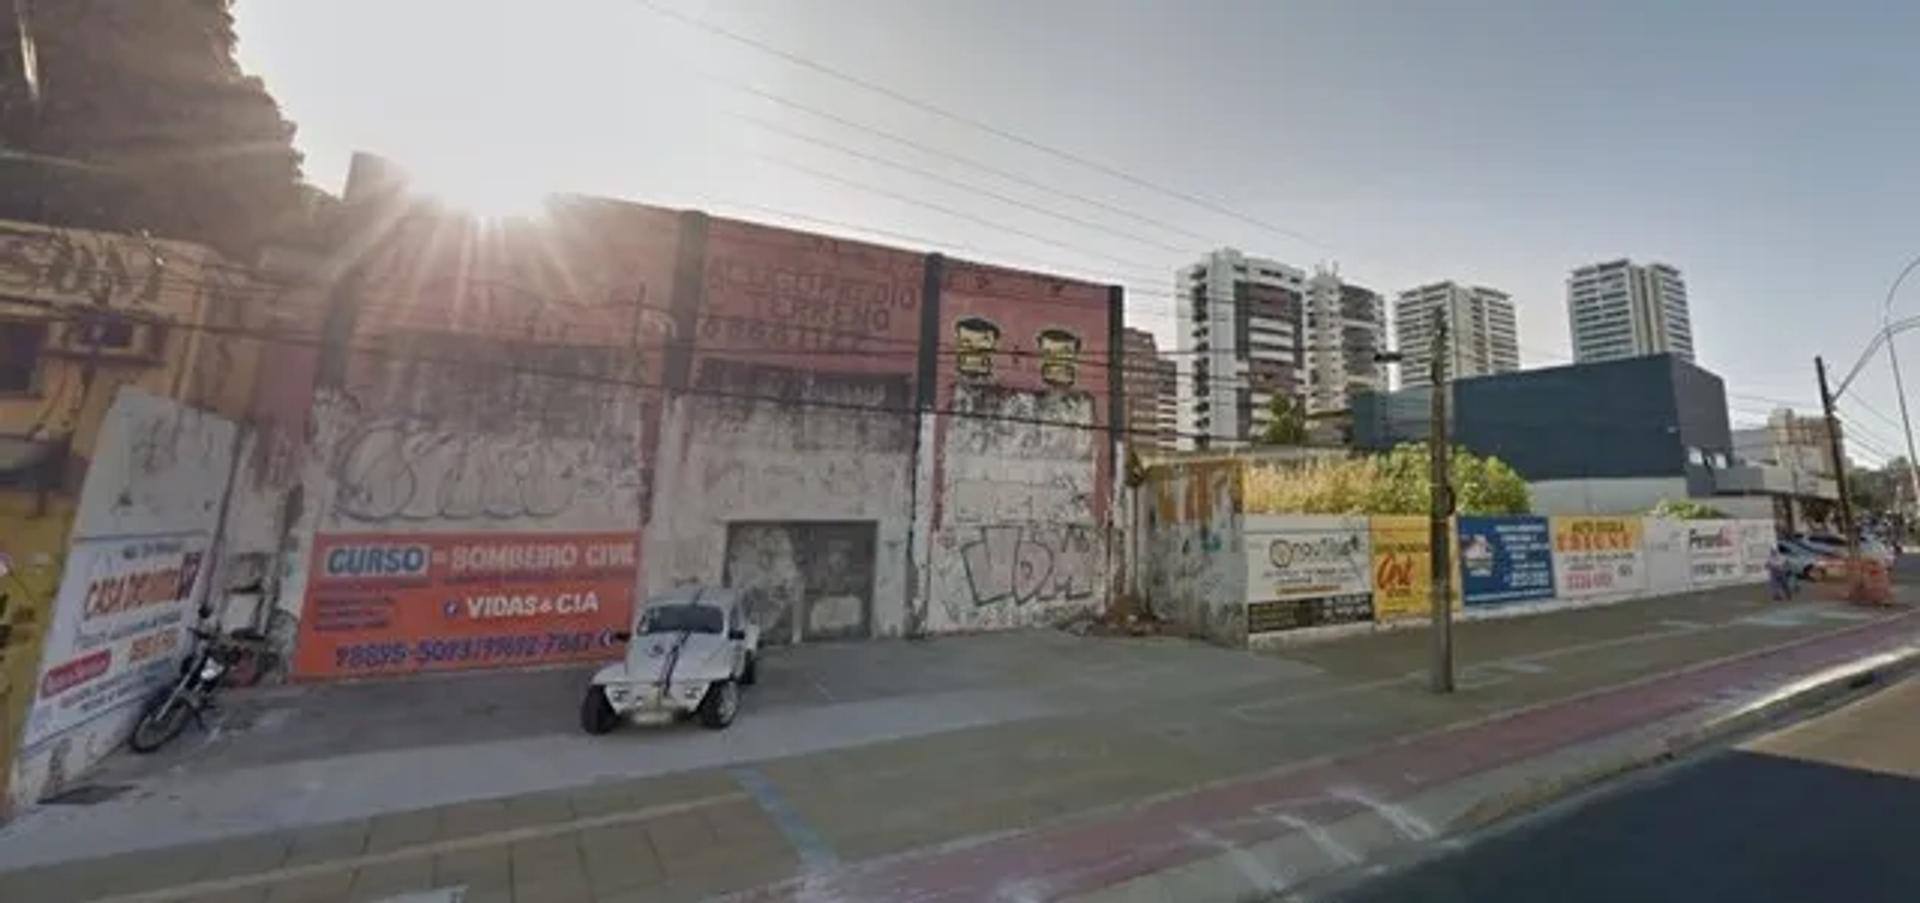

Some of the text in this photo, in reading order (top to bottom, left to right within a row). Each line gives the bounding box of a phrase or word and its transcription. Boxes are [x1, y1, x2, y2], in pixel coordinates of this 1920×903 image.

[327, 546, 425, 575] CURSO
[452, 543, 578, 570] BOMBEIRO
[584, 542, 637, 567] CIVIL
[466, 596, 536, 619] VIDAS
[556, 592, 600, 614] CIA
